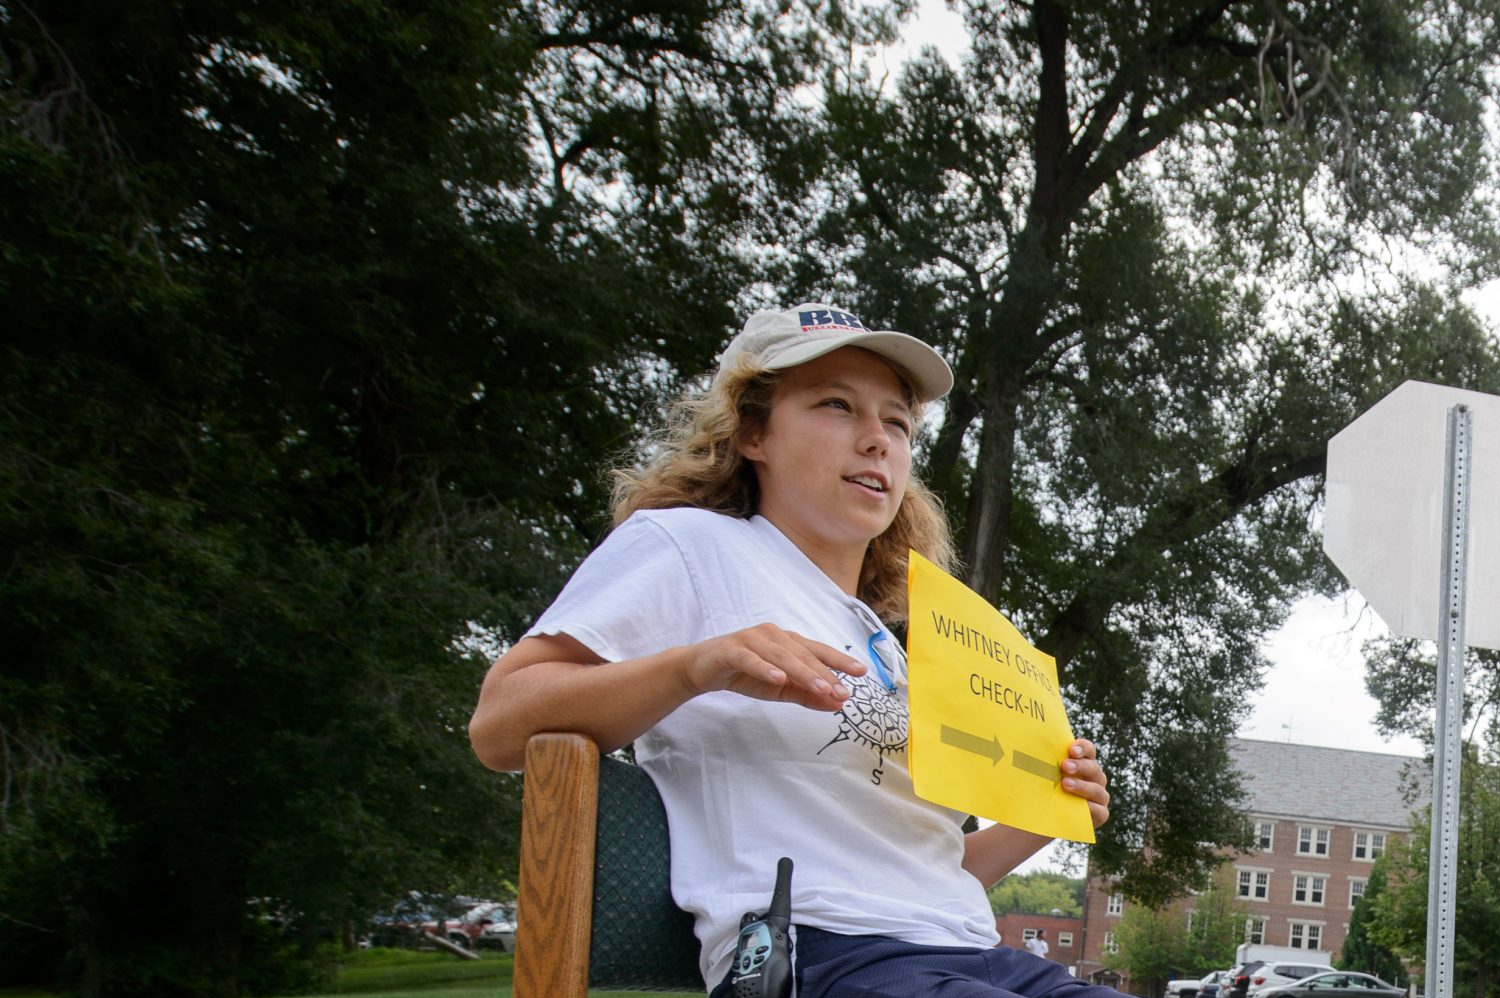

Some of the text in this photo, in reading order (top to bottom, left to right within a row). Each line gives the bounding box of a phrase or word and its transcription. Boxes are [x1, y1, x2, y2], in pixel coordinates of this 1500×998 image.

[931, 610, 1010, 667] WHITNEY
[969, 673, 1046, 722] CHECK-IN
[870, 768, 884, 785] S
